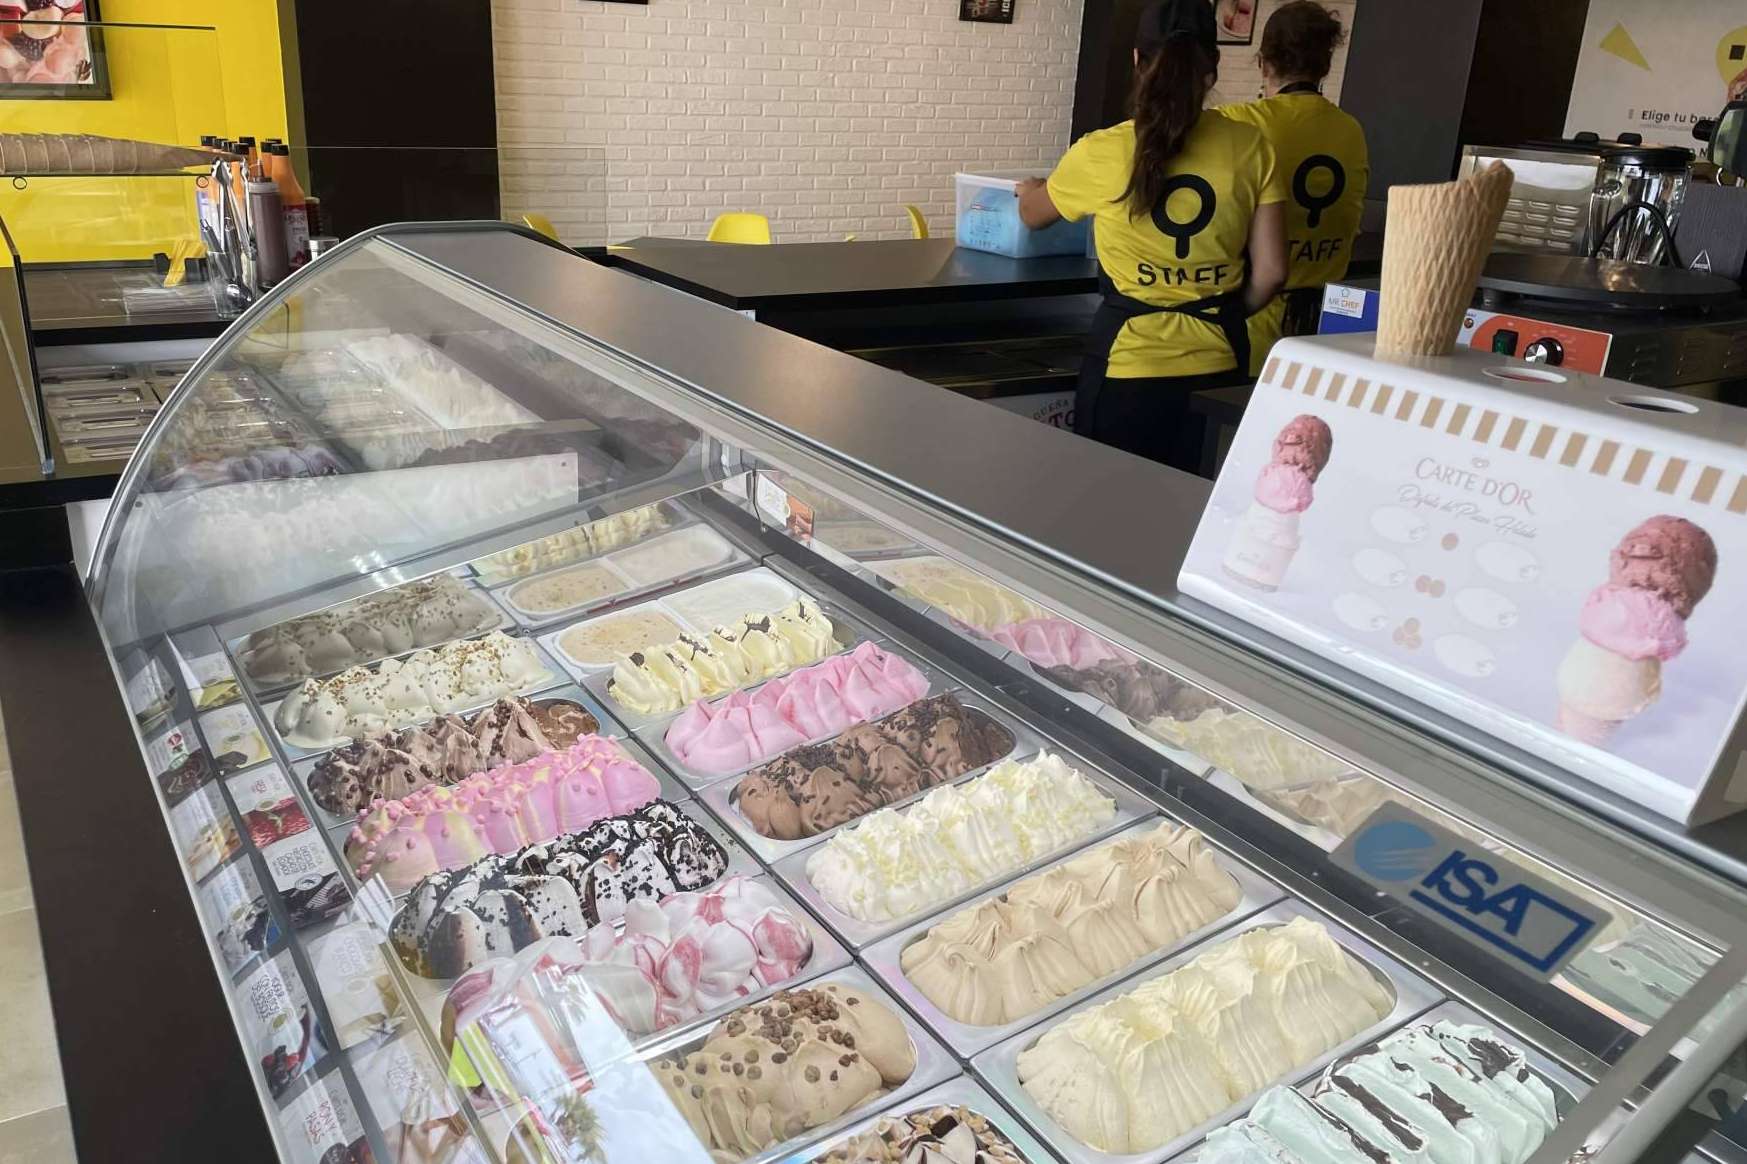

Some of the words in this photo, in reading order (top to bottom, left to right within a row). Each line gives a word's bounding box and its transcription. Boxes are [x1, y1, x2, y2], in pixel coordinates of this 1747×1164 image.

[1641, 109, 1671, 124] Elige
[1674, 111, 1687, 123] tu
[1286, 238, 1344, 262] TAFF
[1137, 263, 1229, 287] STAFF
[1415, 457, 1479, 491] CARTE
[1481, 480, 1536, 515] D'OR
[1421, 850, 1530, 938] ISA
